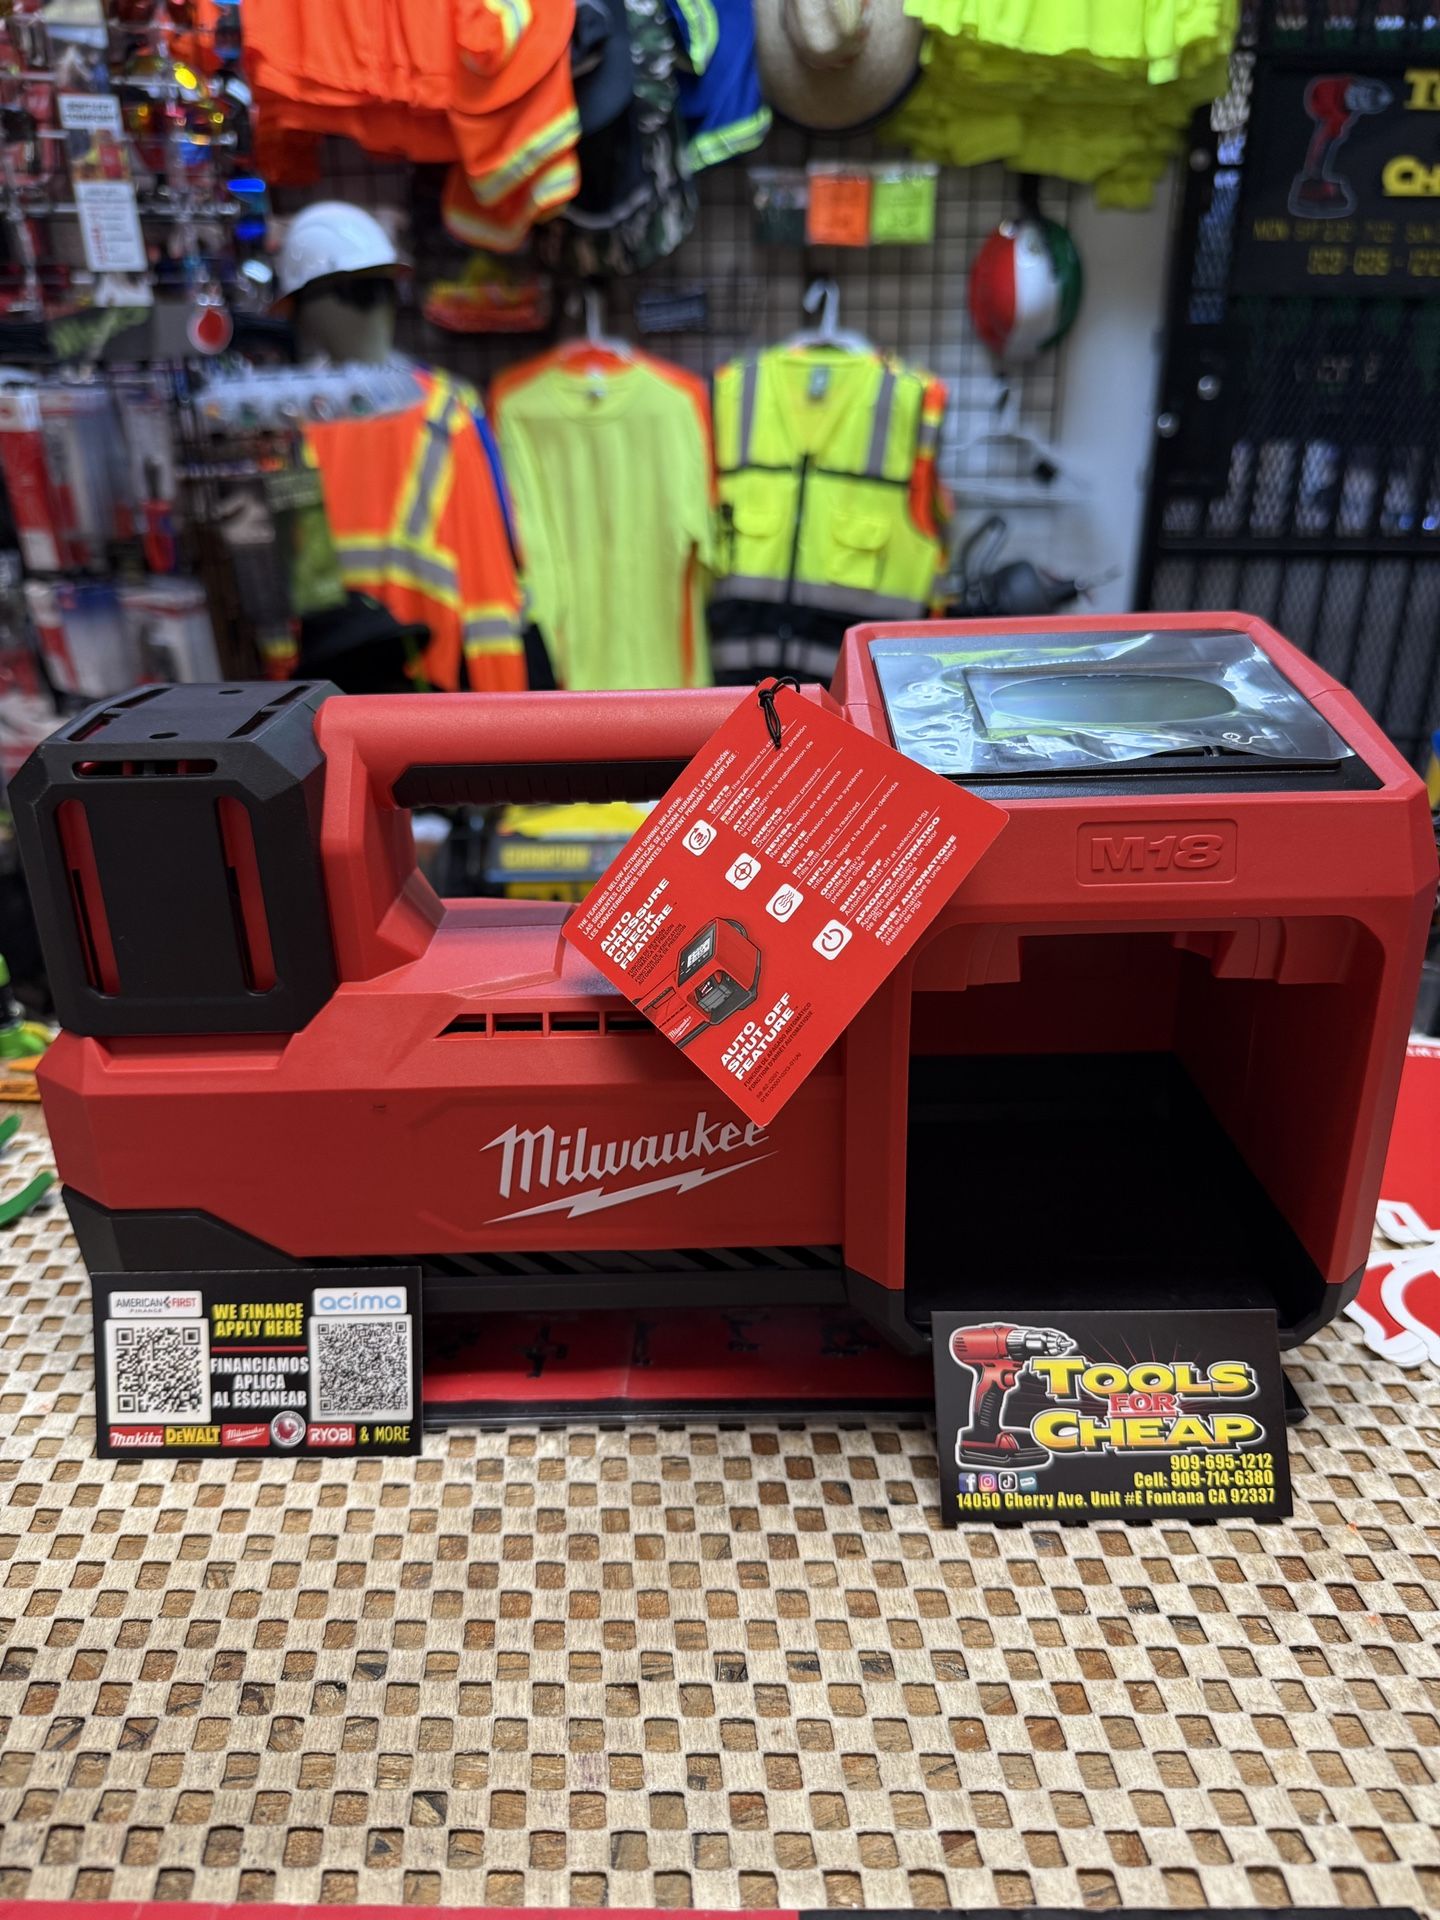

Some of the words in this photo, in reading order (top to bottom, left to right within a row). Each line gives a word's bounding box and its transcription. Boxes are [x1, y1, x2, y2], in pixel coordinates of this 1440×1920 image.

[706, 784, 730, 811] WAITS
[710, 797, 726, 815] Waits
[723, 789, 733, 798] for
[730, 779, 741, 790] the
[738, 753, 761, 780] pressure
[719, 786, 749, 821] ESPERA
[724, 803, 742, 824] Espera
[744, 787, 756, 799] que
[760, 752, 784, 780] estabilice
[736, 809, 757, 834] Attends
[777, 748, 807, 783] stabilisation
[732, 796, 761, 830] ATTEND
[746, 805, 768, 830] pression
[750, 806, 782, 844] CHECKS
[755, 824, 775, 848] Checks
[773, 814, 784, 825] the
[781, 793, 801, 815] system
[798, 767, 822, 794] pressure
[769, 837, 787, 858] Revisa
[820, 769, 841, 794] sistema
[802, 815, 826, 842] pression
[823, 800, 838, 816] dans
[582, 922, 593, 935] LAS
[591, 891, 618, 924] SIGUIENTES
[615, 843, 656, 893] CARACTERÍSTICAS
[653, 835, 662, 845] SE
[659, 812, 680, 837] ACTIVAN
[677, 786, 700, 813] DURANTE
[697, 778, 707, 788] LA
[587, 927, 598, 940] LES
[636, 846, 663, 878] SUIVANTES
[684, 789, 708, 817] PENDANT
[705, 781, 714, 791] LE
[711, 753, 737, 783] GONFLAGE
[764, 821, 793, 855] REVISA
[777, 829, 807, 865] VÉRIFIE
[796, 865, 809, 879] Fills
[806, 851, 820, 866] until
[817, 833, 835, 852] target
[837, 801, 860, 827] reached
[811, 875, 824, 890] Infla
[821, 857, 838, 876] hasta
[835, 840, 852, 859] llegar
[876, 781, 899, 807] definida
[1091, 834, 1224, 872] M18
[577, 917, 588, 930] THE
[585, 890, 609, 919] FEATURES
[607, 870, 624, 891] BELOW
[621, 845, 644, 872] ACTIVATE
[641, 824, 660, 847] DURING
[657, 795, 683, 826] INFLATION:
[791, 848, 814, 875] FILLS
[806, 857, 830, 886] INFLA
[819, 857, 851, 896] GONFLE
[824, 877, 844, 900] Gonfle
[859, 829, 882, 856] achever
[829, 875, 853, 903] pression
[851, 859, 866, 876] cible
[843, 882, 872, 916] Automatic
[869, 857, 892, 884] shut-off
[895, 821, 920, 850] selected
[916, 809, 929, 823] PSI
[853, 877, 892, 924] APAGADO
[889, 815, 941, 878] AUTOMÁTICO
[859, 896, 885, 927] Apagado
[922, 829, 938, 847] valor
[838, 878, 867, 912] SHUTS
[865, 858, 883, 879] OFF
[871, 908, 884, 922] PSI
[881, 865, 918, 909] seleccionado
[873, 904, 902, 938] ARRÊT
[899, 834, 957, 905] AUTOMATIQUE
[892, 883, 927, 925] automatique
[928, 864, 942, 879] une
[939, 844, 958, 865] valeur
[605, 877, 669, 957] PRESSURE
[909, 900, 922, 914] PSI
[598, 910, 632, 951] AUTO
[612, 910, 656, 963] CHECK
[619, 903, 673, 970] FEATURE
[718, 1019, 756, 1066] AUTO
[726, 1026, 765, 1073] SHUT
[762, 991, 792, 1026] OFF
[734, 1006, 794, 1080] FEATURE
[480, 1111, 770, 1199] Milwaukee
[116, 1297, 163, 1308] AMERICAN
[171, 1297, 197, 1308] FIRST
[212, 1303, 238, 1320] WE
[239, 1302, 304, 1320] FINANCE
[319, 1292, 402, 1311] acima
[214, 1320, 261, 1337] APPLY
[263, 1319, 303, 1337] HERE
[210, 1356, 310, 1375] FINANCIAMOS
[232, 1373, 286, 1392] APLICA
[1031, 1357, 1257, 1398] TOOLS
[212, 1391, 231, 1408] AL
[232, 1390, 308, 1408] ESCANEAR
[1109, 1393, 1178, 1417] FOR
[311, 1427, 354, 1442] RYOBI
[360, 1425, 370, 1443] &
[375, 1425, 412, 1444] MORE
[1031, 1410, 1264, 1452] CHEAP
[1133, 1471, 1168, 1489] Cell:
[1170, 1470, 1274, 1488] 909-714-6380
[1169, 1453, 1273, 1471] 909-695-1212
[956, 1493, 1000, 1509] 14050
[1004, 1492, 1054, 1510] Cherry
[1057, 1491, 1088, 1508] Ave.
[1090, 1491, 1121, 1506] Unit
[1124, 1491, 1144, 1506] #E
[1146, 1489, 1205, 1506] Fontana
[1208, 1489, 1228, 1505] CA
[1230, 1487, 1276, 1505] 92337
